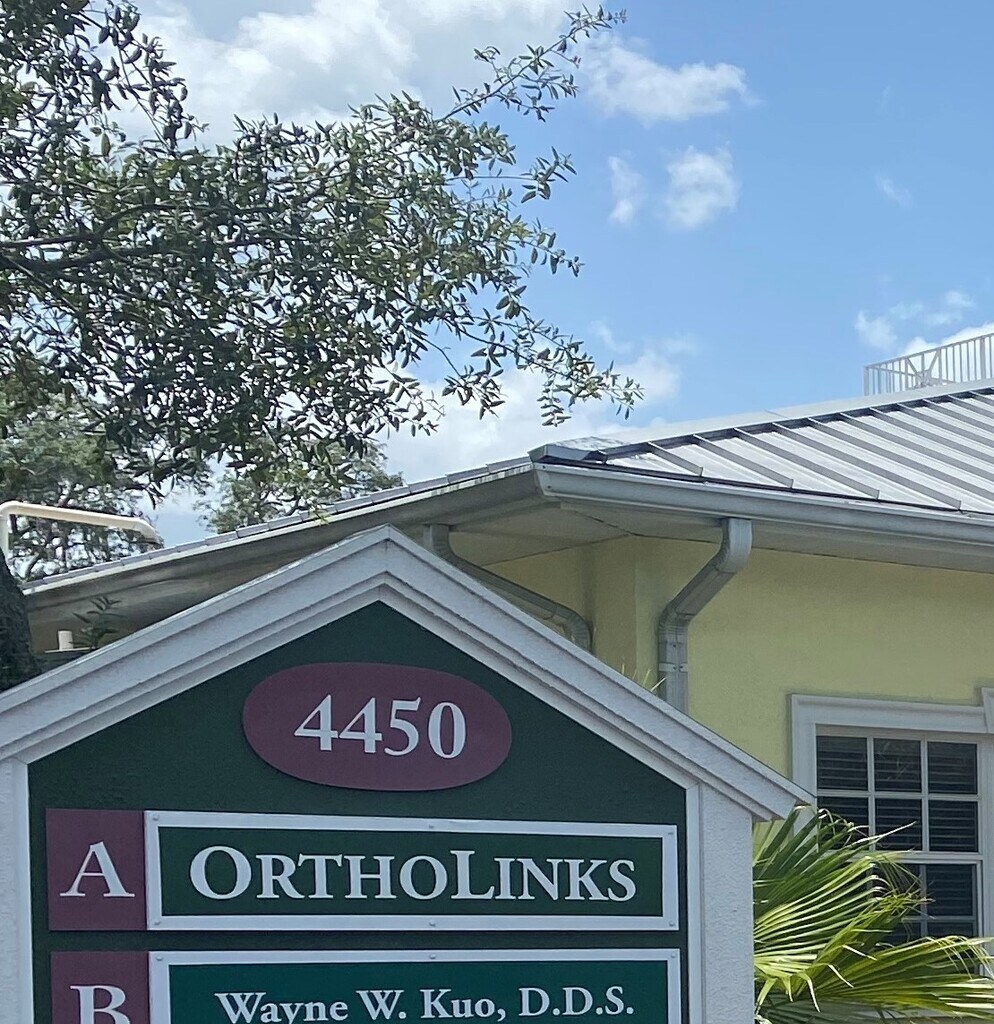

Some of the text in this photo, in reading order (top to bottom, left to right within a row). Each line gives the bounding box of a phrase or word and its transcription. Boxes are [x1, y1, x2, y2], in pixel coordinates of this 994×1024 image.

[294, 695, 466, 759] 4450
[60, 842, 135, 898] A
[356, 989, 407, 1021] W.
[419, 988, 506, 1022] Kuo,
[518, 986, 634, 1017] D.D.S.
